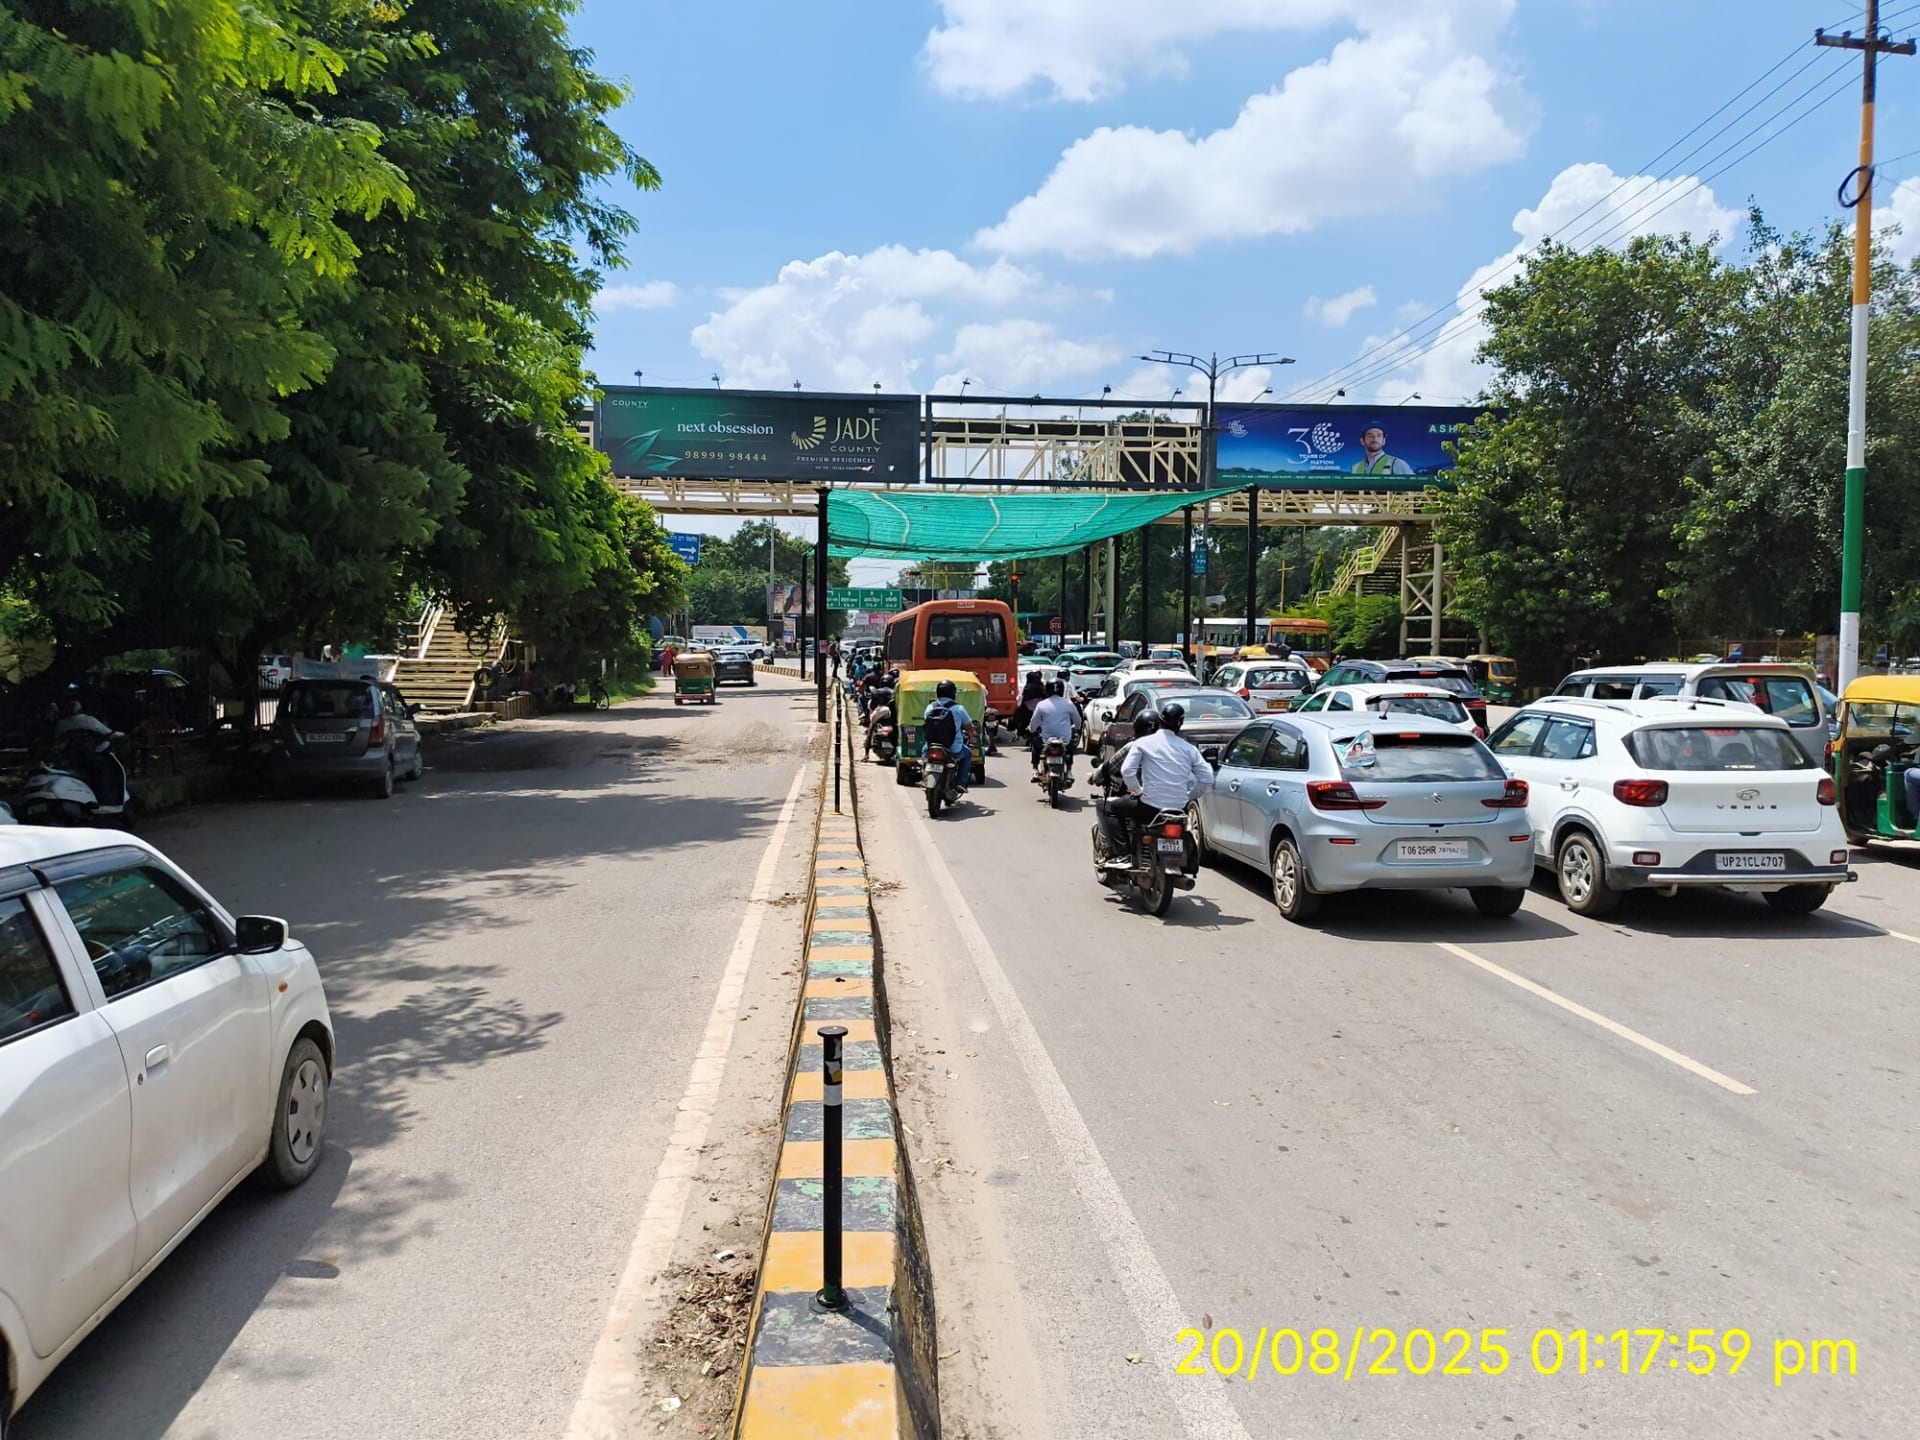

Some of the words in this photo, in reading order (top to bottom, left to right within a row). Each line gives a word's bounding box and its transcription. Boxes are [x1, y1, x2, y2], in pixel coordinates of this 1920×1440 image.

[611, 399, 649, 407] COUNTY
[677, 421, 706, 433] next
[708, 421, 774, 435] obsession
[829, 416, 882, 445] JADE
[830, 445, 881, 453] COUNTY
[684, 450, 724, 460] 98999
[728, 451, 767, 462] 98444
[1722, 855, 1784, 867] UP21CL4707
